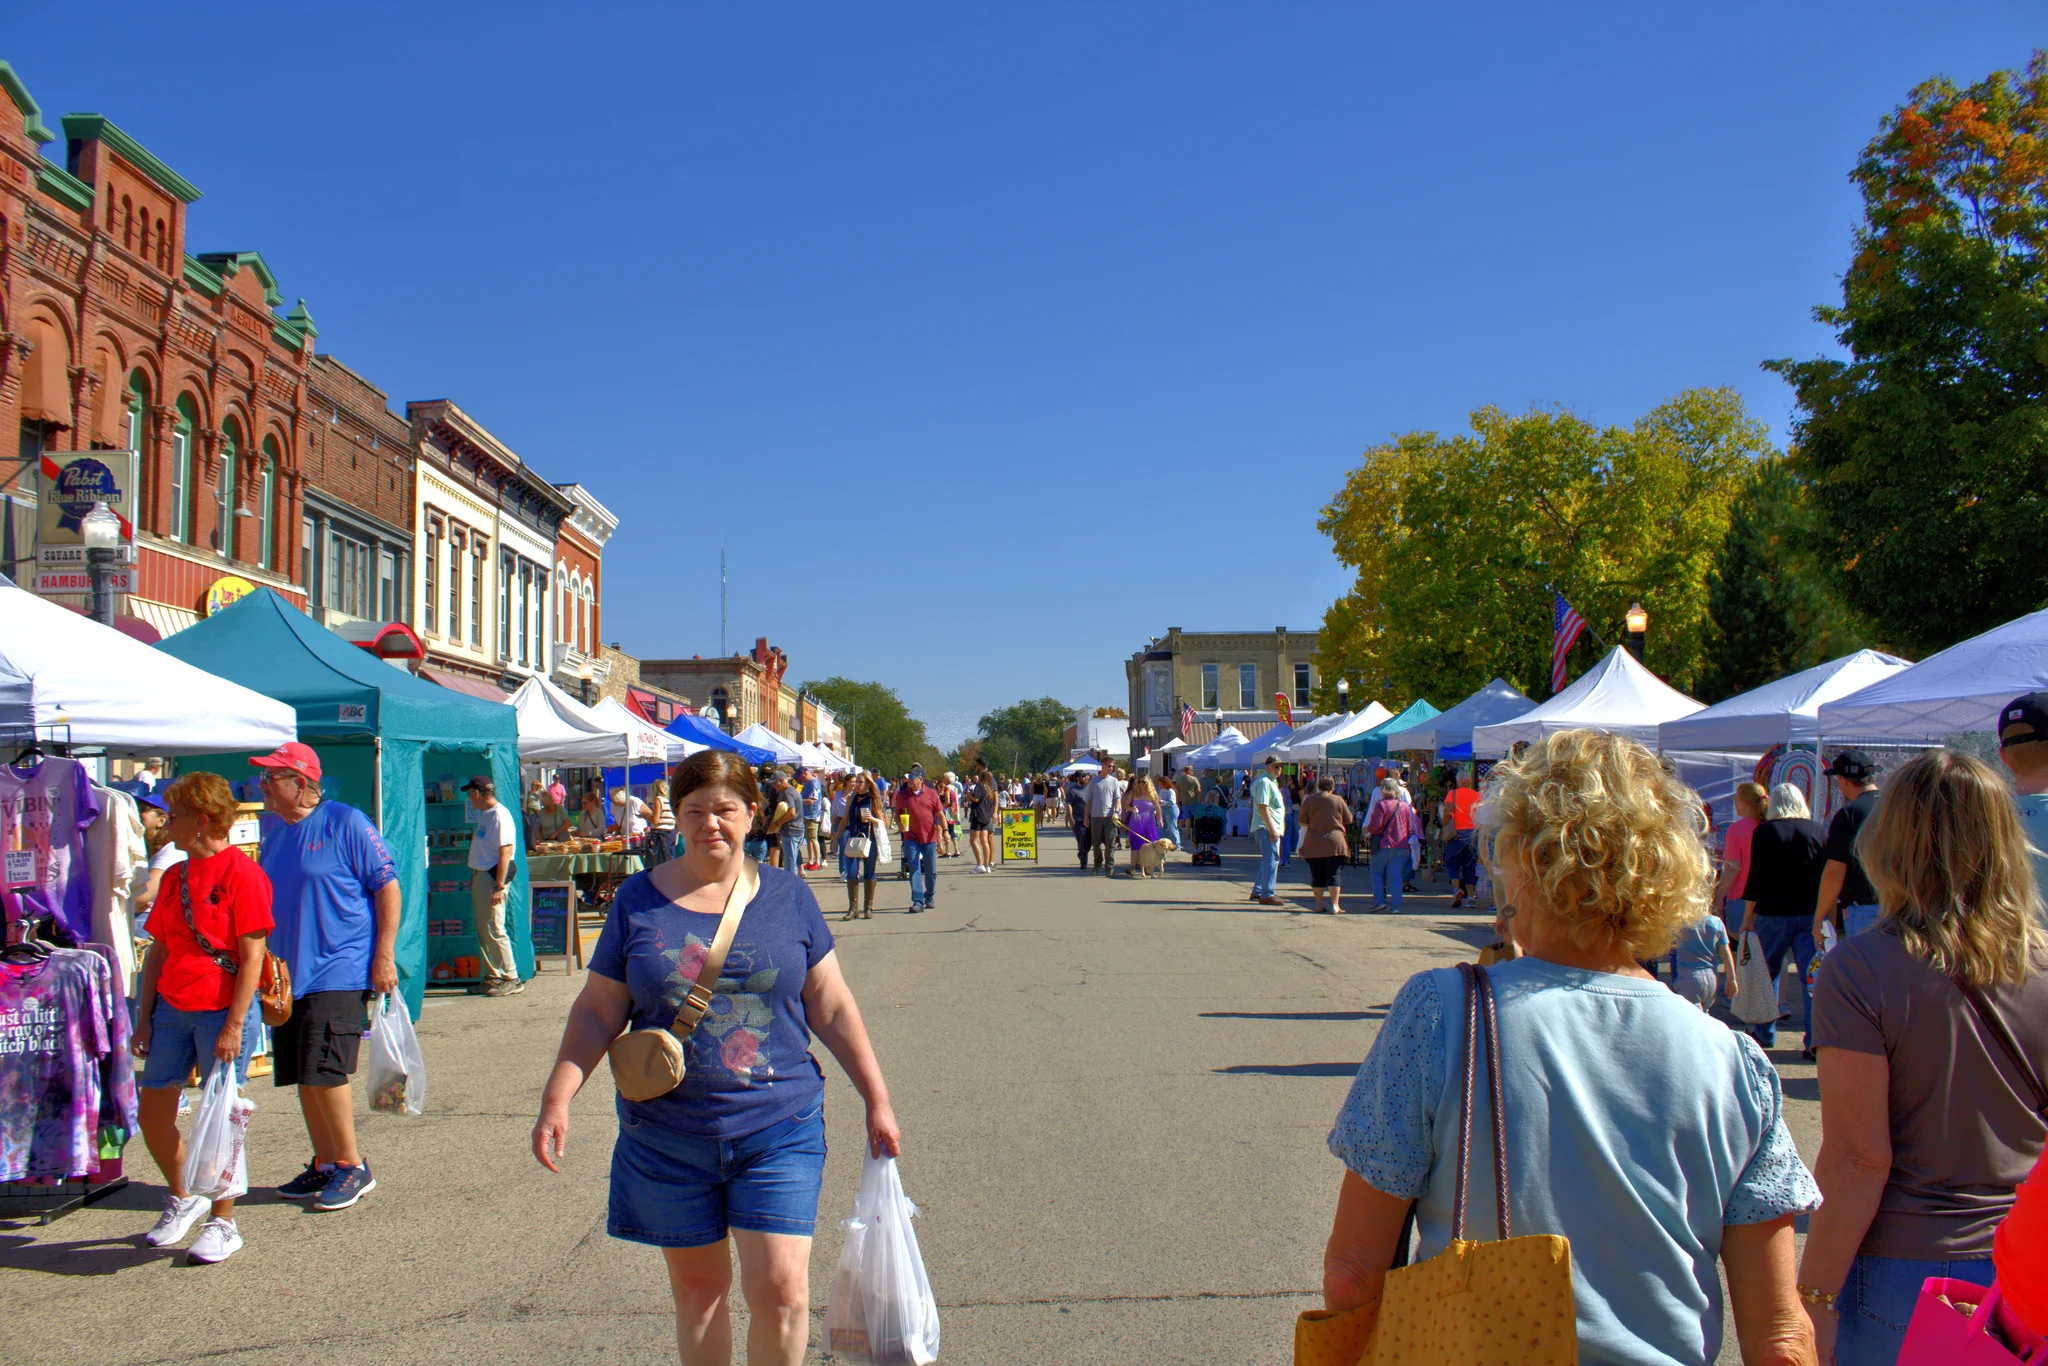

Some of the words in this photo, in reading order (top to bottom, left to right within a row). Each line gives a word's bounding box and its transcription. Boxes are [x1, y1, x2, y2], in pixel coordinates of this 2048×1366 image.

[230, 305, 265, 338] ASHLEY
[64, 467, 105, 486] Pabst
[50, 490, 74, 503] Blue
[76, 489, 121, 503] Ribbon
[44, 551, 82, 561] SQUARE
[343, 706, 365, 718] ABC
[655, 928, 665, 940] A
[0, 1009, 20, 1025] ust
[34, 1006, 66, 1024] little
[8, 1025, 32, 1040] ray
[34, 1025, 48, 1039] of
[28, 1034, 66, 1053] black
